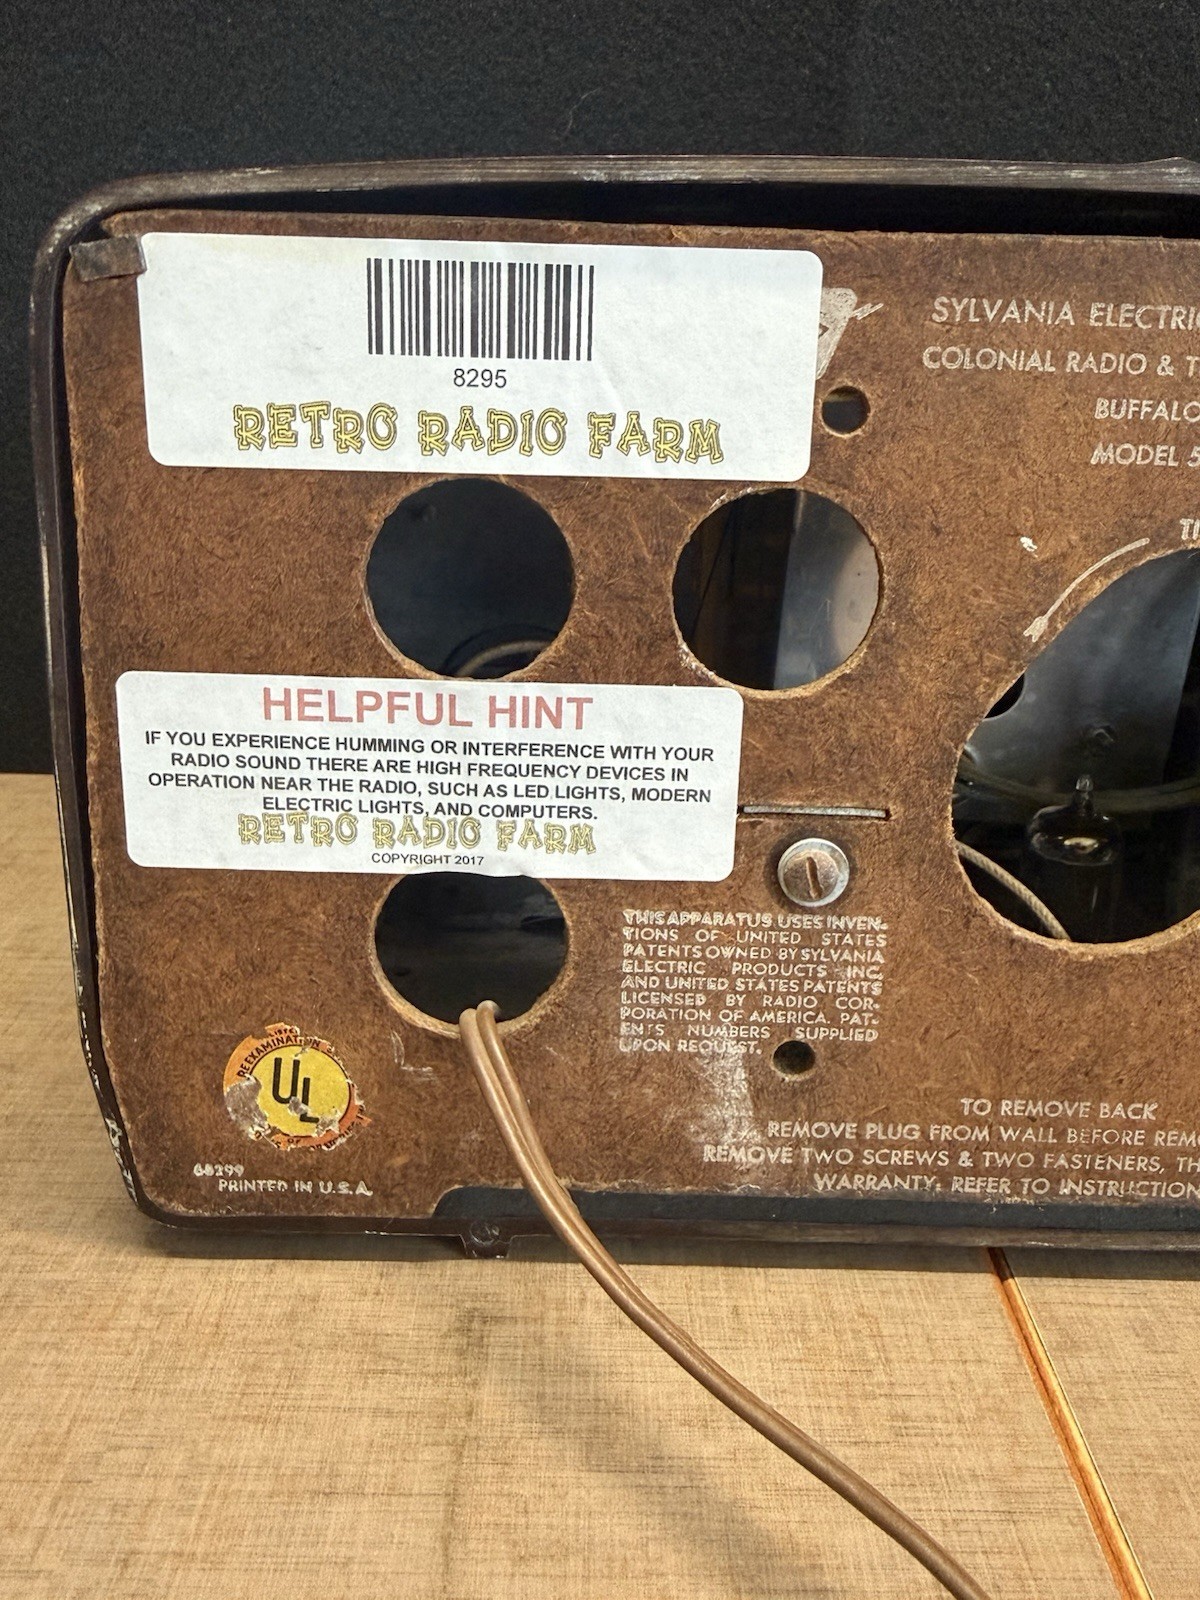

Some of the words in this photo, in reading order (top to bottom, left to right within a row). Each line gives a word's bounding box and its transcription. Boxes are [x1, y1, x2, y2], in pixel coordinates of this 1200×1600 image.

[931, 296, 1075, 325] SYLVANIA
[1089, 302, 1200, 331] ELECTRI
[922, 346, 1056, 372] COLONIAL
[1065, 351, 1148, 375] RADIO
[1156, 354, 1175, 377] &
[453, 368, 507, 389] 8295
[1094, 397, 1200, 423] BUFFALO
[233, 401, 398, 454] RETRO
[418, 405, 568, 457] RADIO
[587, 410, 725, 464] FARM
[1090, 443, 1179, 467] MODEL
[1187, 445, 1200, 467] 5
[263, 687, 473, 727] HELPFUL
[488, 695, 593, 730] HINT
[145, 731, 161, 745] IF
[166, 731, 206, 746] YOU
[212, 733, 330, 750] EXPERIENCE
[336, 737, 424, 753] HUMMING
[431, 740, 457, 755] OR
[463, 741, 605, 759] INTERFERENCE
[610, 745, 656, 760] WITH
[662, 747, 714, 761] YOUR
[171, 752, 230, 768] RADIO
[236, 755, 301, 770] SOUND
[306, 757, 368, 772] THERE
[373, 759, 411, 773] ARE
[417, 760, 461, 776] HIGH
[467, 763, 581, 779] FREQUENCY
[587, 766, 665, 781] DEVICES
[671, 768, 689, 781] IN
[149, 773, 255, 789] OPERATION
[261, 776, 312, 791] NEAR
[317, 778, 354, 793] THE
[359, 780, 421, 797] RADIO,
[428, 782, 478, 797] SUCH
[483, 784, 507, 798] AS
[514, 785, 549, 799] LED
[555, 786, 625, 803] LIGHTS,
[631, 787, 711, 803] MODERN
[262, 797, 353, 812] ELECTRIC
[358, 799, 429, 816] LIGHTS,
[434, 802, 472, 816] AND
[478, 804, 598, 820] COMPUTERS.
[238, 813, 358, 847] RETRO
[372, 815, 481, 850] RADIO
[496, 818, 597, 854] FARM
[371, 852, 451, 865] COPYRIGHT
[454, 855, 485, 866] 2017
[622, 908, 665, 925] THIS
[667, 910, 772, 928] APPARATUS
[777, 913, 823, 929] USES
[622, 927, 678, 942] TIONS
[695, 929, 718, 943] OF
[736, 930, 801, 944] UNITED
[822, 932, 887, 946] STATES
[623, 943, 702, 959] PATENTS
[705, 946, 771, 960] OWNED
[778, 948, 798, 961] BY
[801, 948, 885, 964] SYLVANIA
[622, 960, 706, 974] ELECTRIC
[732, 962, 827, 977] PRODUCTS
[621, 975, 660, 989] AND
[665, 976, 728, 990] UNITED
[735, 978, 799, 993] STATES
[804, 980, 882, 996] PATENTS
[621, 991, 706, 1006] LICENSED
[726, 994, 746, 1007] BY
[763, 994, 818, 1008] RADIO
[620, 1006, 711, 1021] PORATION
[719, 1008, 743, 1022] OF
[749, 1010, 830, 1024] AMERICA.
[620, 1021, 665, 1036] ENTS
[688, 1023, 770, 1039] NUMBERS
[794, 1027, 879, 1042] SUPPLIED
[619, 1037, 671, 1052] UPON
[961, 1098, 992, 1116] TO
[1001, 1099, 1091, 1118] REMOVE
[1099, 1102, 1159, 1120] BACK
[768, 1120, 857, 1139] REMOVE
[865, 1122, 920, 1140] PLUG
[929, 1124, 990, 1142] FROM
[1000, 1126, 1057, 1143] WALL
[1067, 1128, 1145, 1146] BEFORE
[1154, 1130, 1200, 1147] REM
[703, 1144, 793, 1164] REMOVE
[801, 1147, 854, 1166] TWO
[862, 1149, 949, 1166] SCREWS
[958, 1150, 973, 1167] &
[982, 1152, 1034, 1169] TWO
[1043, 1153, 1165, 1174] FASTENERS,
[218, 1179, 288, 1192] PRINTED
[295, 1181, 312, 1193] IN
[951, 1176, 1011, 1194] REFER
[1020, 1178, 1050, 1194] TO
